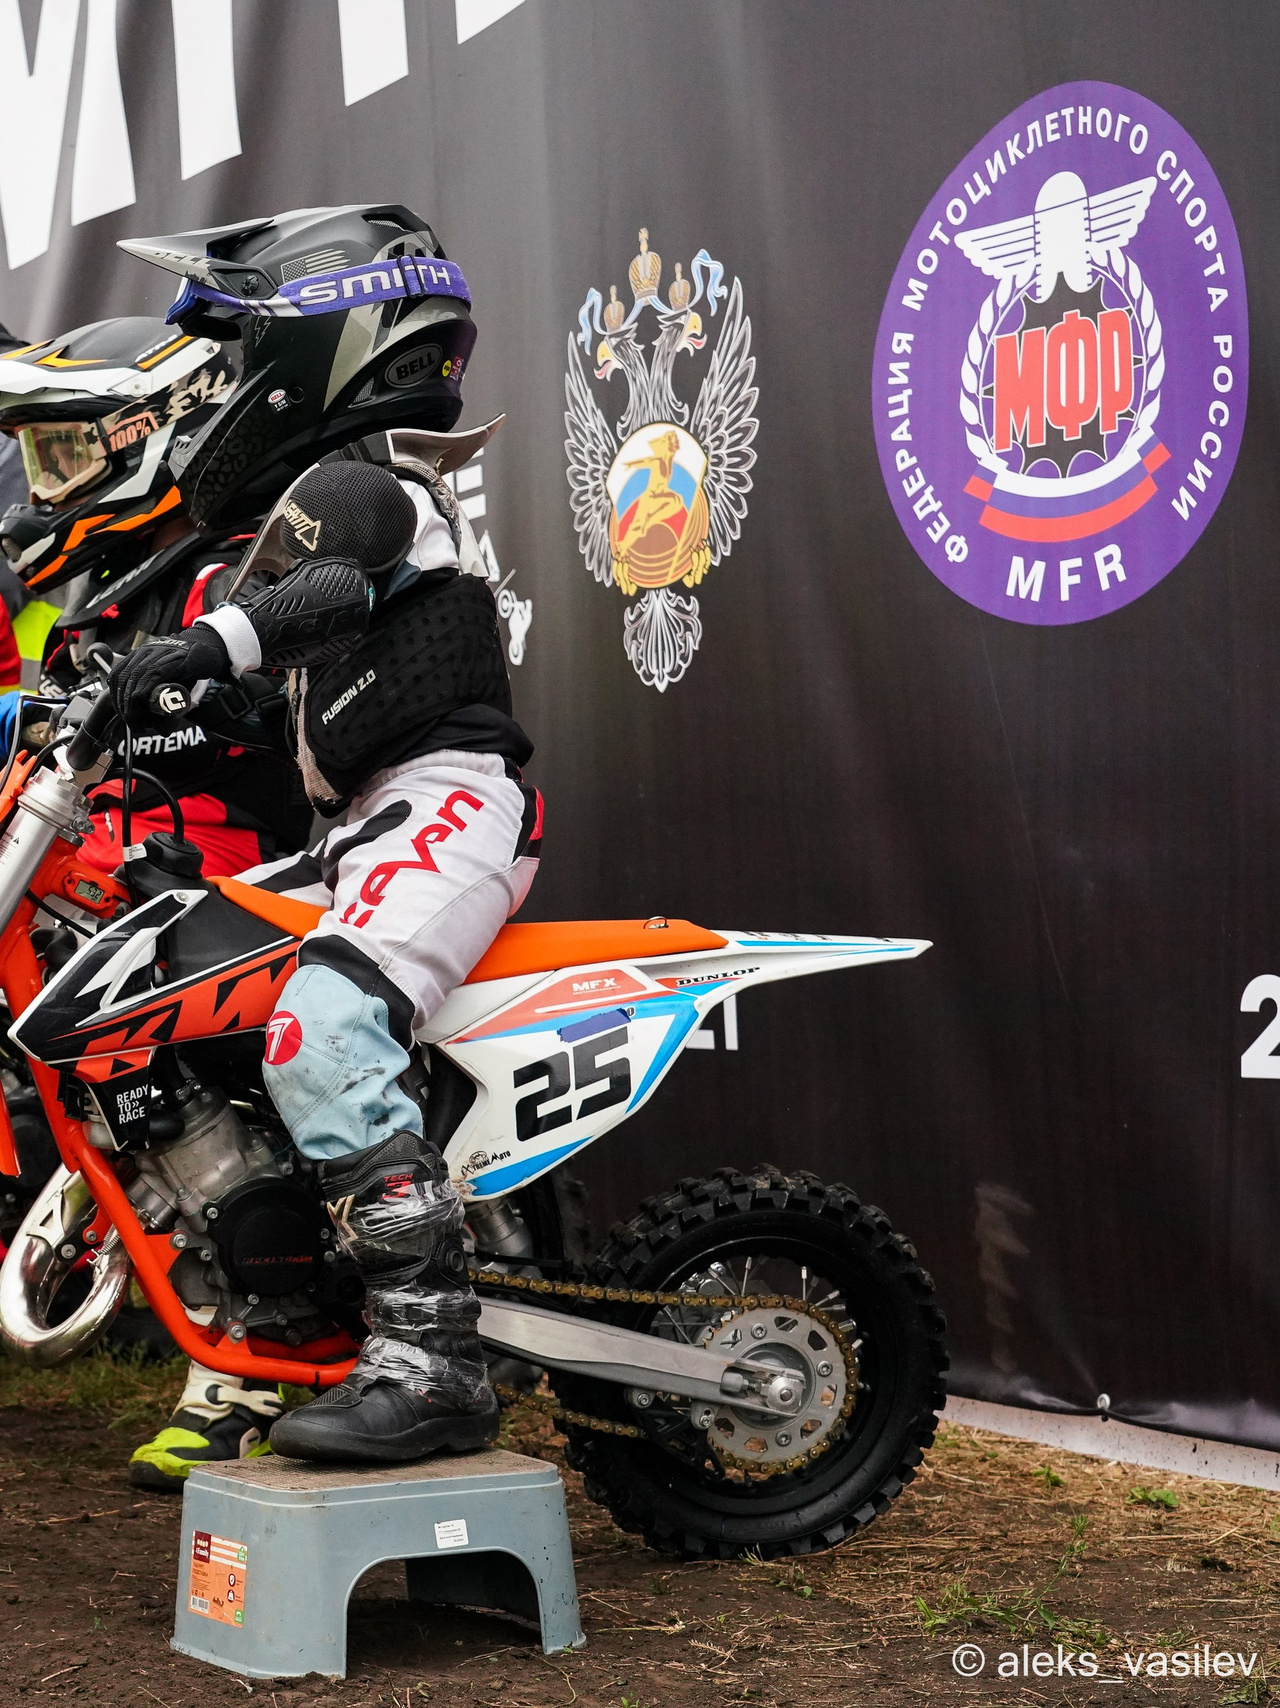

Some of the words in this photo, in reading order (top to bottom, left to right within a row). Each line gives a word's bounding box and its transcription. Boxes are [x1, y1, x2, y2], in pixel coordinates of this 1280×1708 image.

[902, 106, 1148, 311] МОТОЦИКЛЕТНОГО
[1156, 150, 1229, 312] СПОРТА
[299, 264, 451, 306] SMITH
[395, 351, 435, 381] BELL
[992, 308, 1134, 453] МФР
[109, 417, 152, 451] 100%
[888, 331, 969, 564] ФЕДЕРАЦИЯ
[1171, 333, 1233, 521] РОССИИ
[1005, 543, 1127, 602] MFR
[321, 685, 358, 725] FUSION
[357, 669, 376, 691] 2.0
[572, 977, 617, 992] MFX
[677, 966, 760, 987] DUNLOP
[116, 1083, 149, 1106] READY
[513, 1026, 632, 1142] 25
[118, 1106, 146, 1125] RACE
[383, 1173, 414, 1183] TECH
